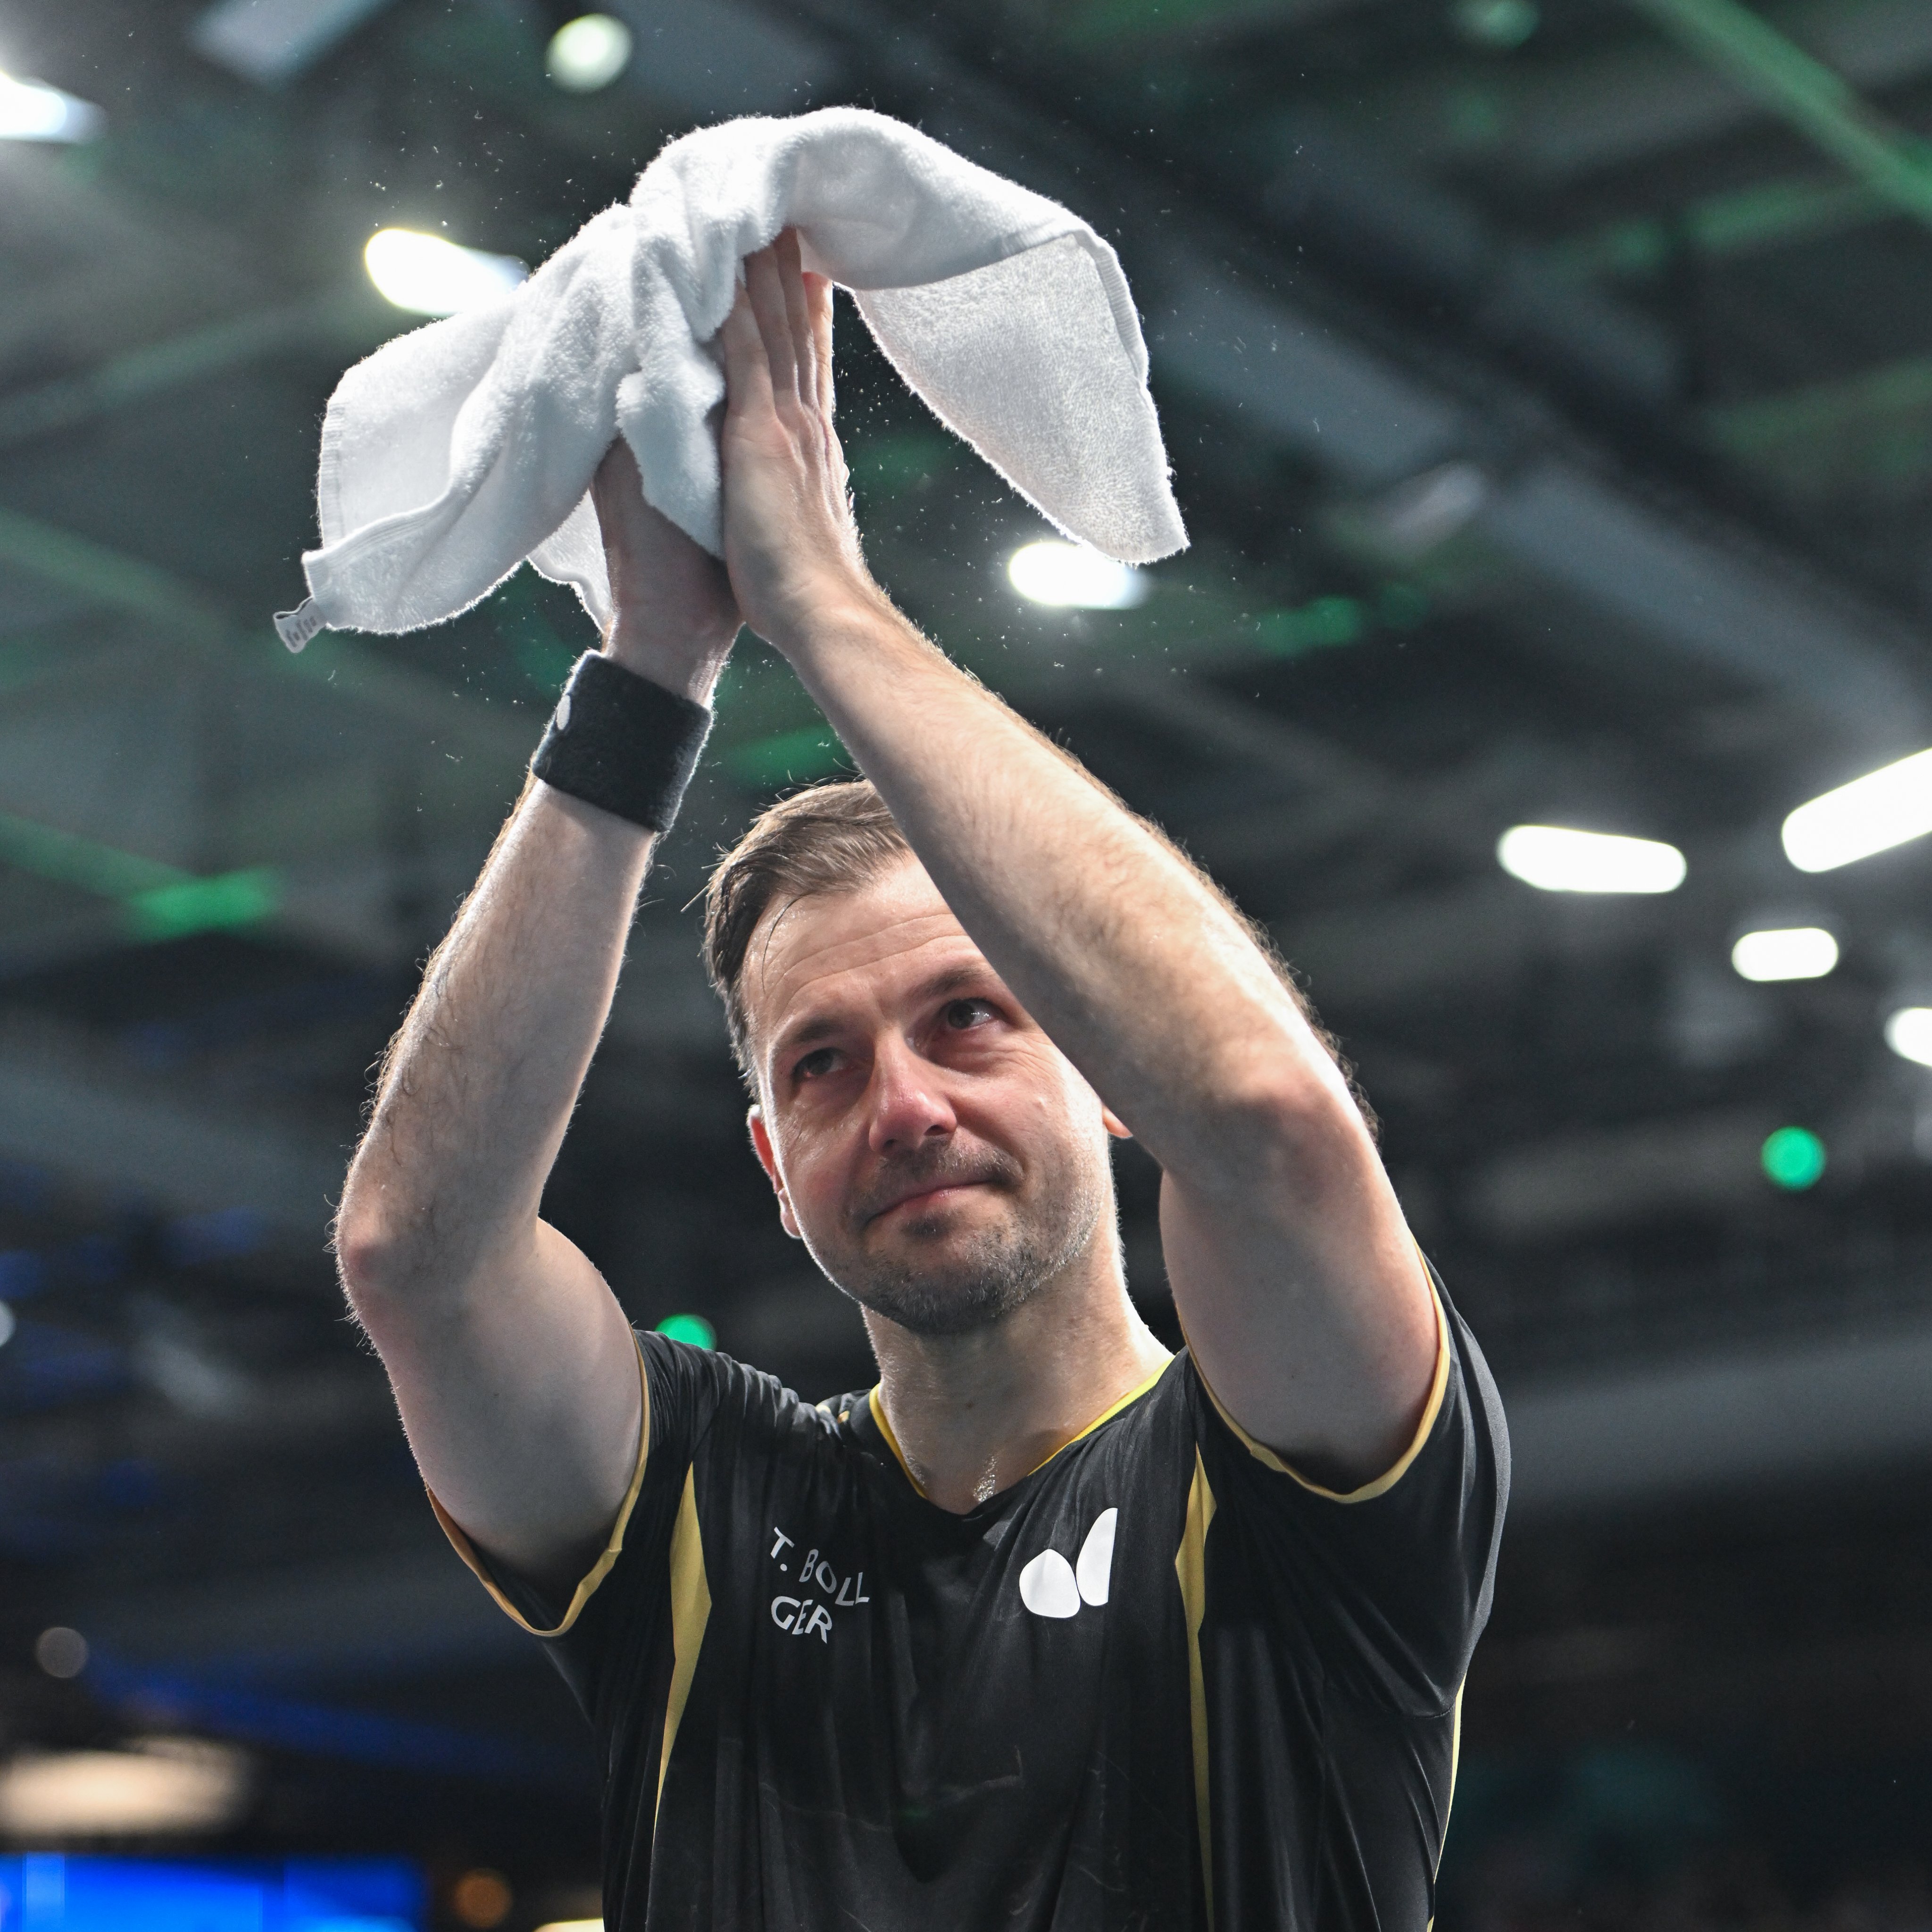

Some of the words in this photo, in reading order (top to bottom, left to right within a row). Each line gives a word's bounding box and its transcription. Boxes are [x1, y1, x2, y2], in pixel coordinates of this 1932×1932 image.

[770, 1526, 795, 1572] T.
[799, 1549, 870, 1606] BOLL
[771, 1596, 833, 1644] GER
